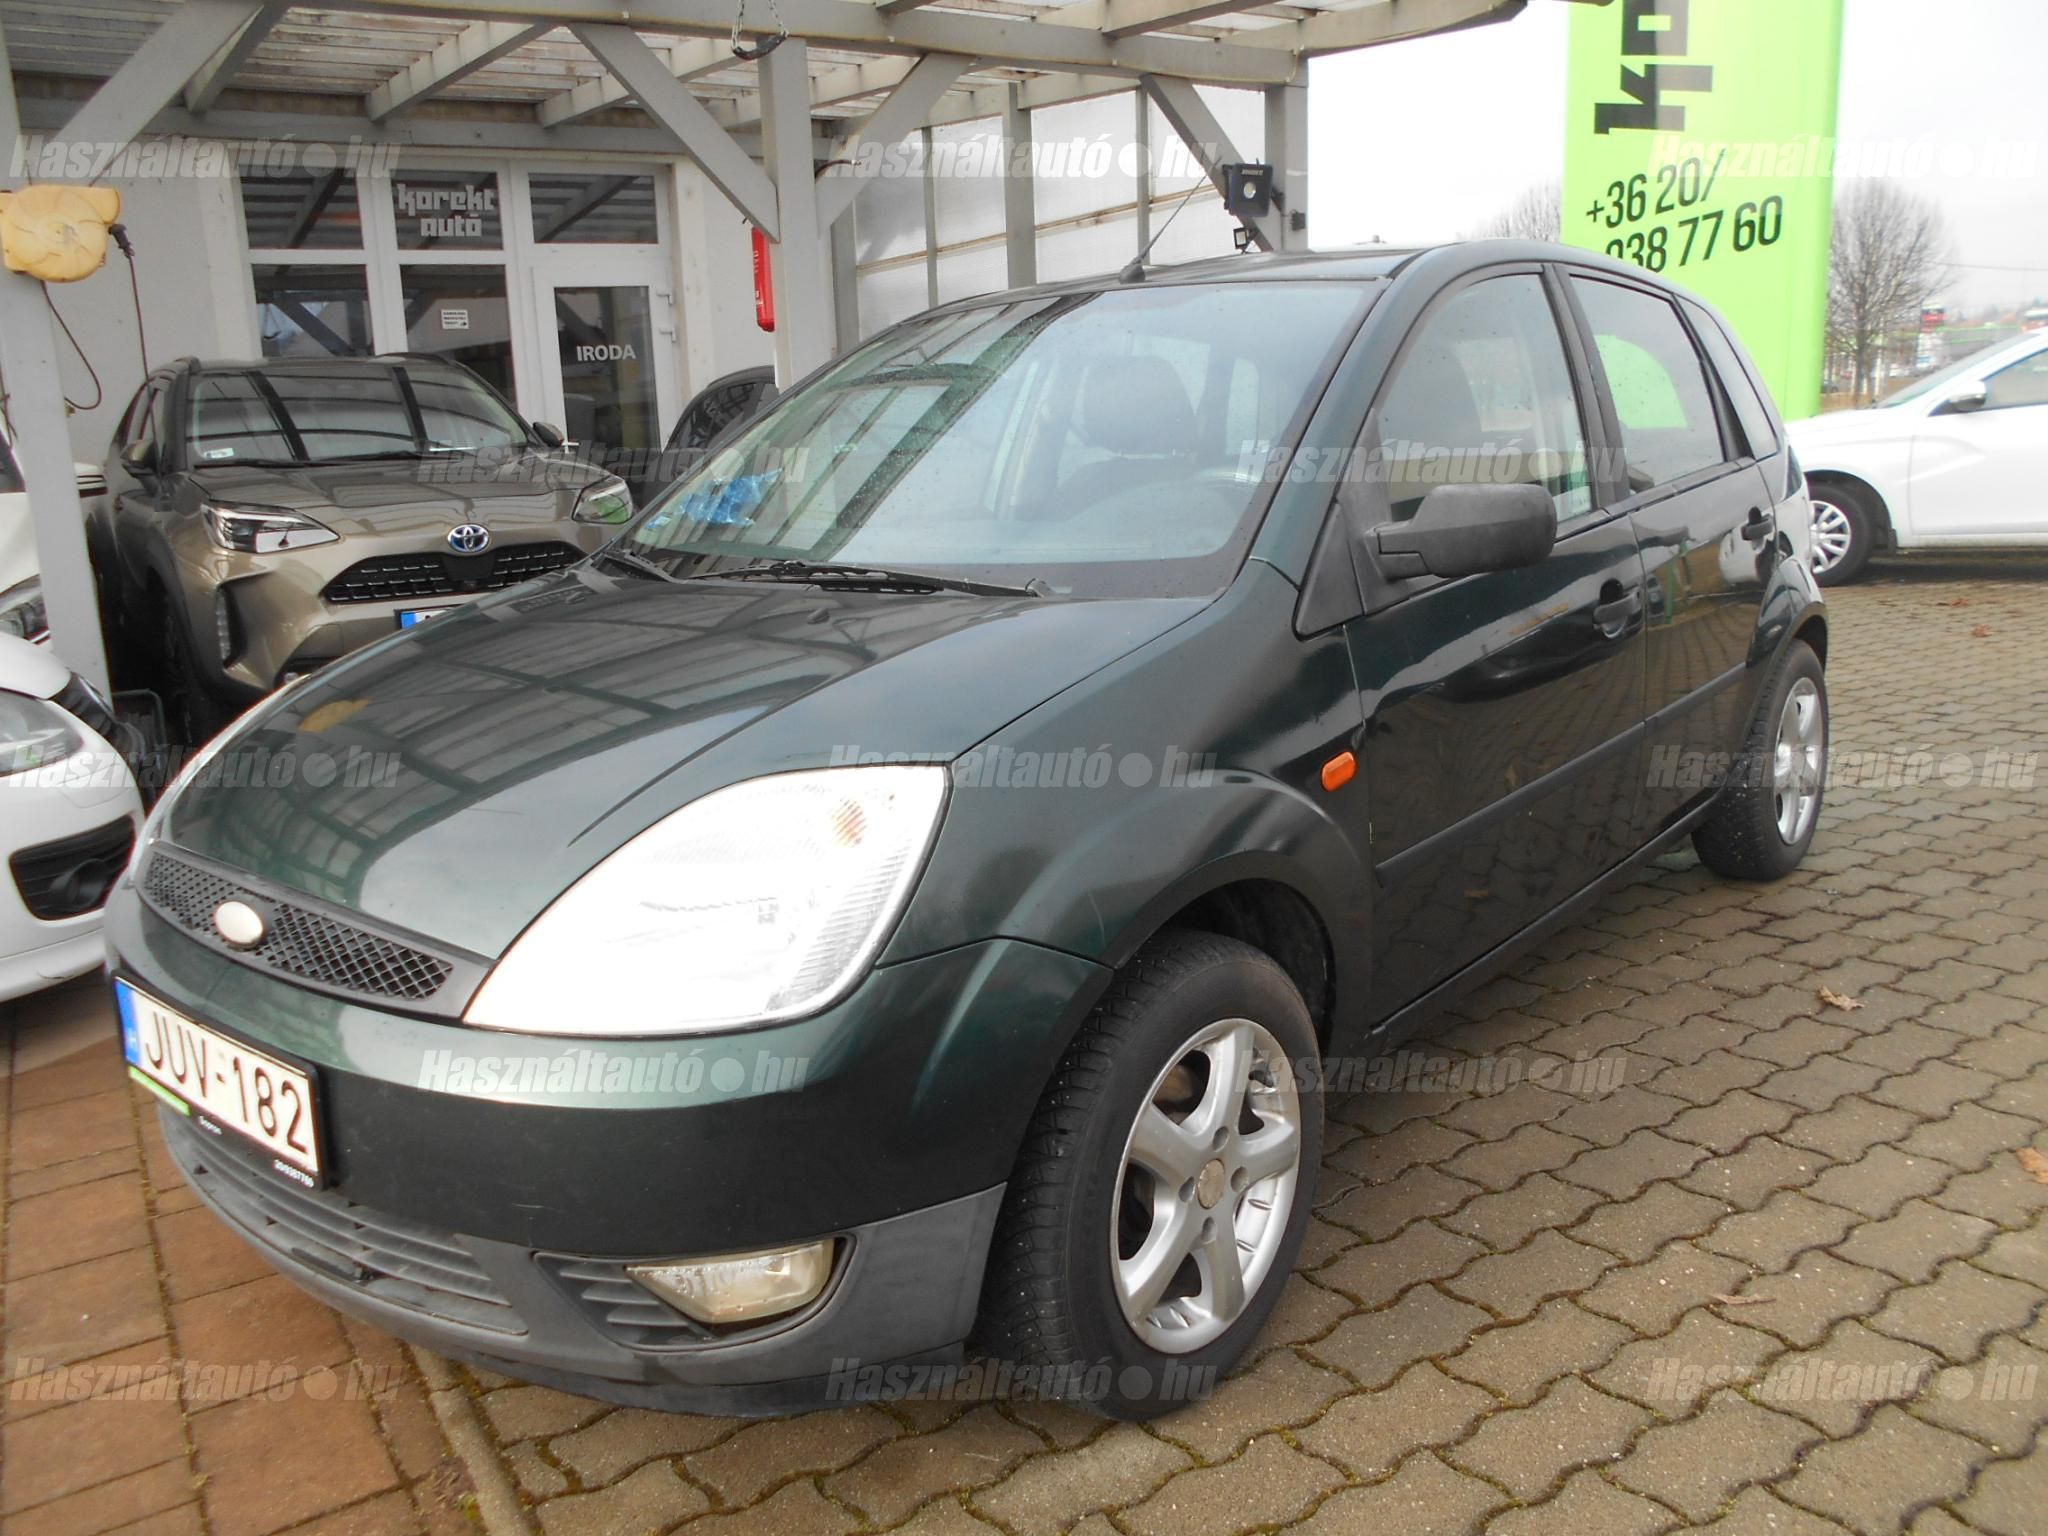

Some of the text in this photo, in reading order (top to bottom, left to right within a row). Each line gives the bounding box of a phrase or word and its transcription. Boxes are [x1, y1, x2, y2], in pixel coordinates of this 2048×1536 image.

[397, 183, 495, 216] korekt
[1586, 173, 1647, 229] +36
[421, 213, 482, 237] autó
[1678, 209, 1724, 267] 77
[1732, 195, 1783, 252] 60
[576, 344, 636, 361] IRODA
[145, 1009, 309, 1155] JUV-182
